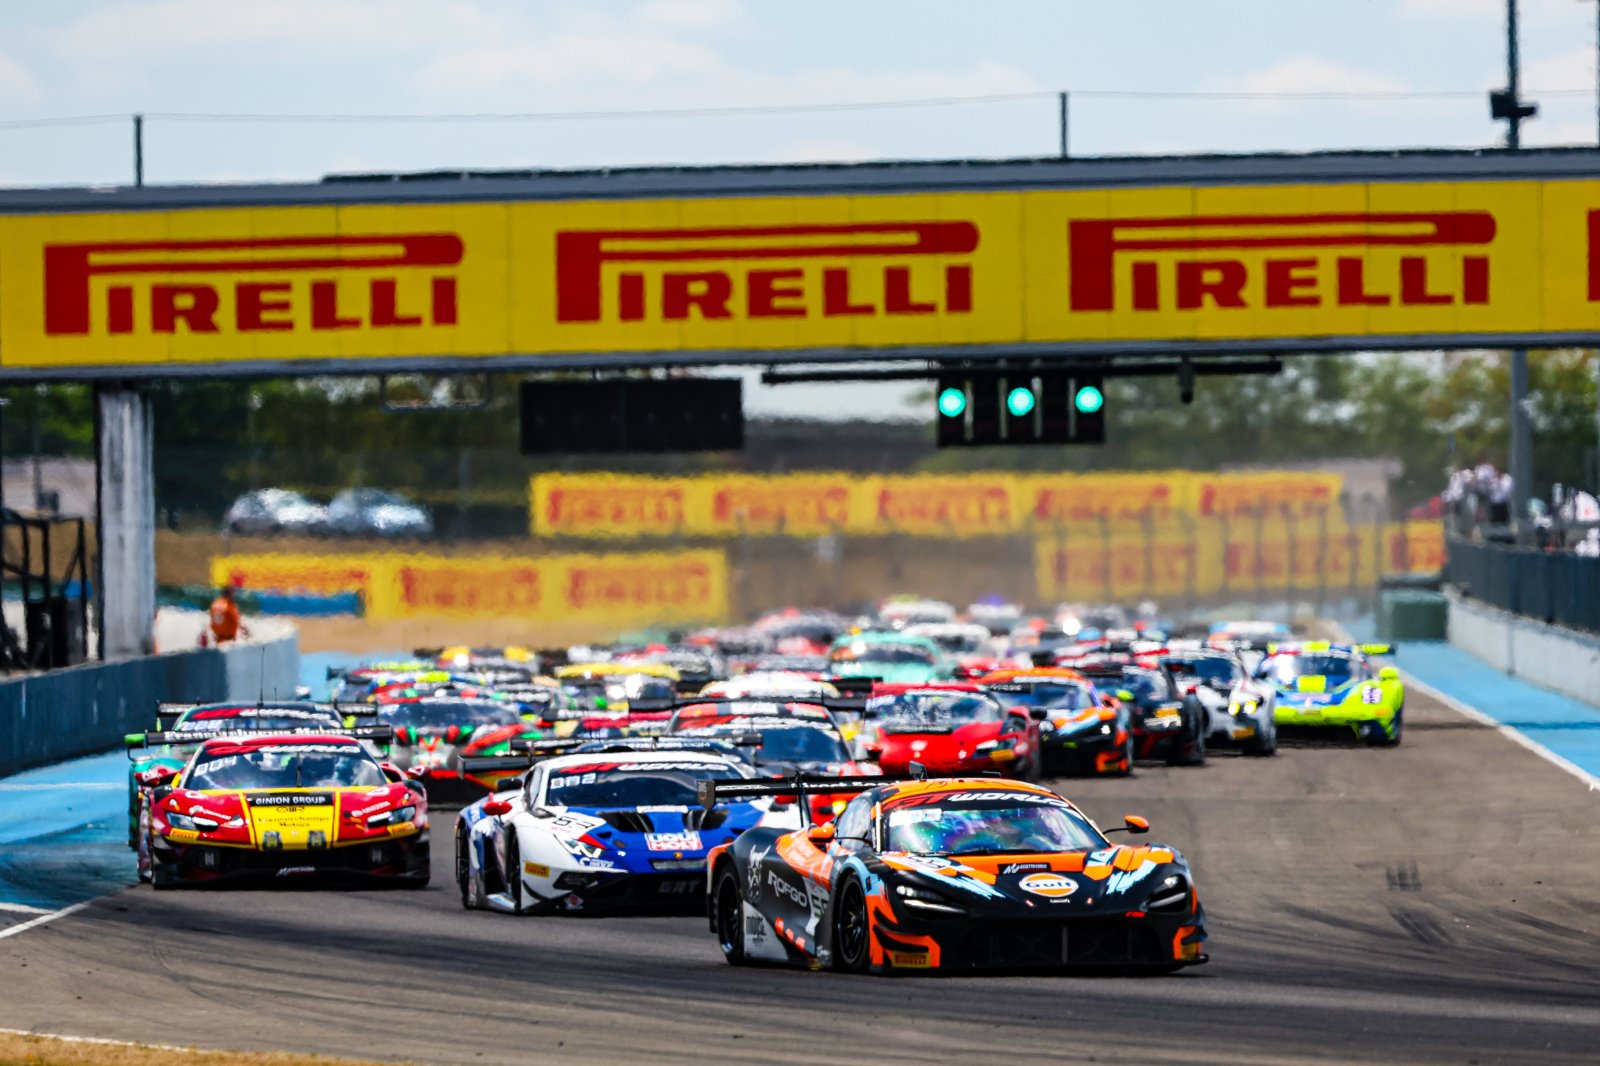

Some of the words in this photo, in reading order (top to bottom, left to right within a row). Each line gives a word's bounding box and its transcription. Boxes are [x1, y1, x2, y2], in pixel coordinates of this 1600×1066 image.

[1069, 210, 1496, 311] PIRELLI
[556, 221, 980, 324] PIRELLI
[44, 233, 464, 335] PIRELLI
[256, 797, 290, 805] GINION
[292, 796, 326, 804] GROUP
[947, 792, 1069, 808] WORLD
[648, 832, 698, 842] LIQUI
[650, 840, 701, 850] MOLY
[658, 880, 701, 893] GRT
[767, 870, 808, 907] ROFGO
